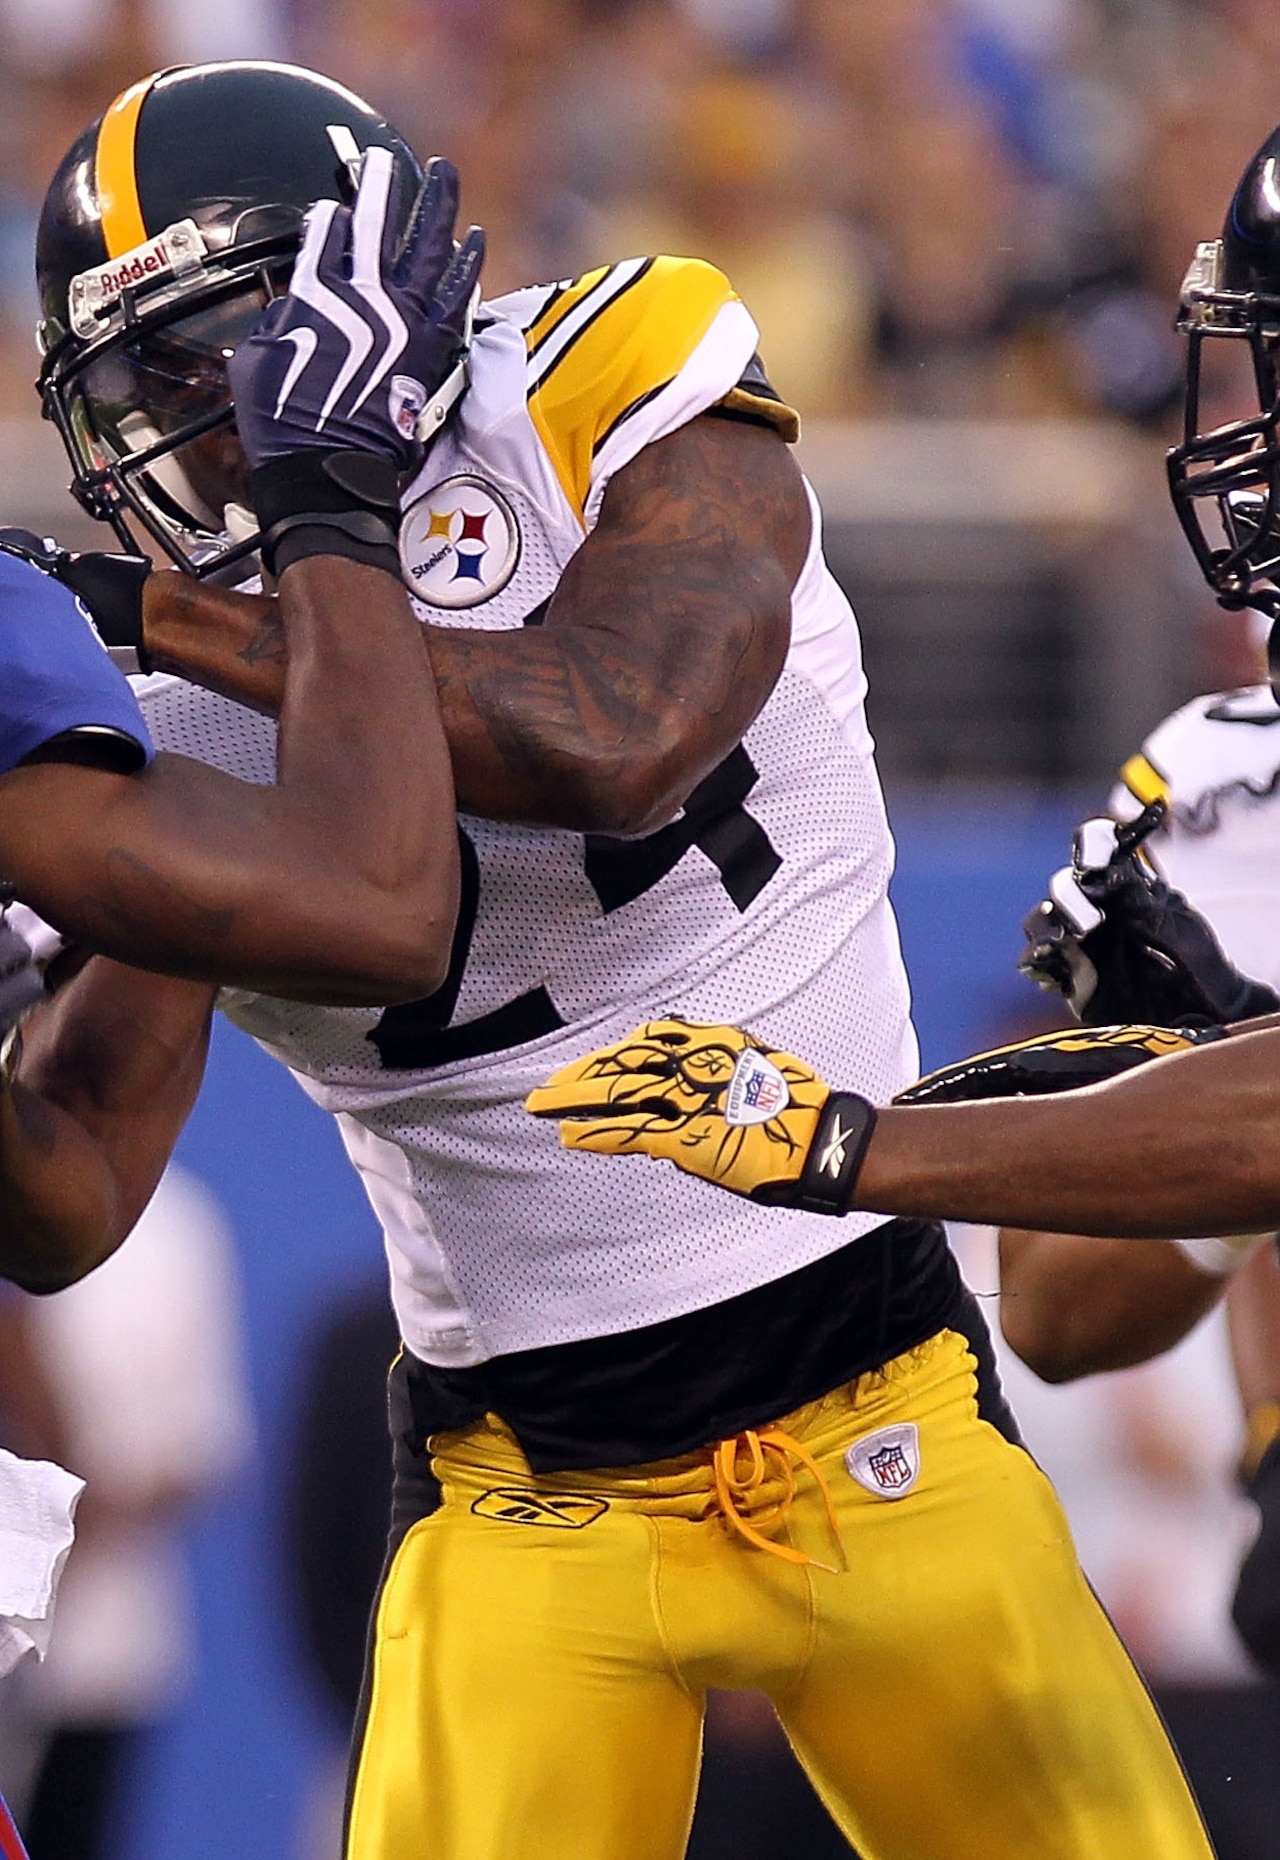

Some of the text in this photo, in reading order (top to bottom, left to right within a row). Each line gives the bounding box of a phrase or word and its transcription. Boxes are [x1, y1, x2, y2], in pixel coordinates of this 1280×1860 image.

[100, 244, 171, 296] Riddell
[411, 543, 453, 580] Steelers
[729, 1051, 756, 1119] EQUIPMENT
[757, 1079, 782, 1111] NFL
[876, 1460, 909, 1485] NFL
